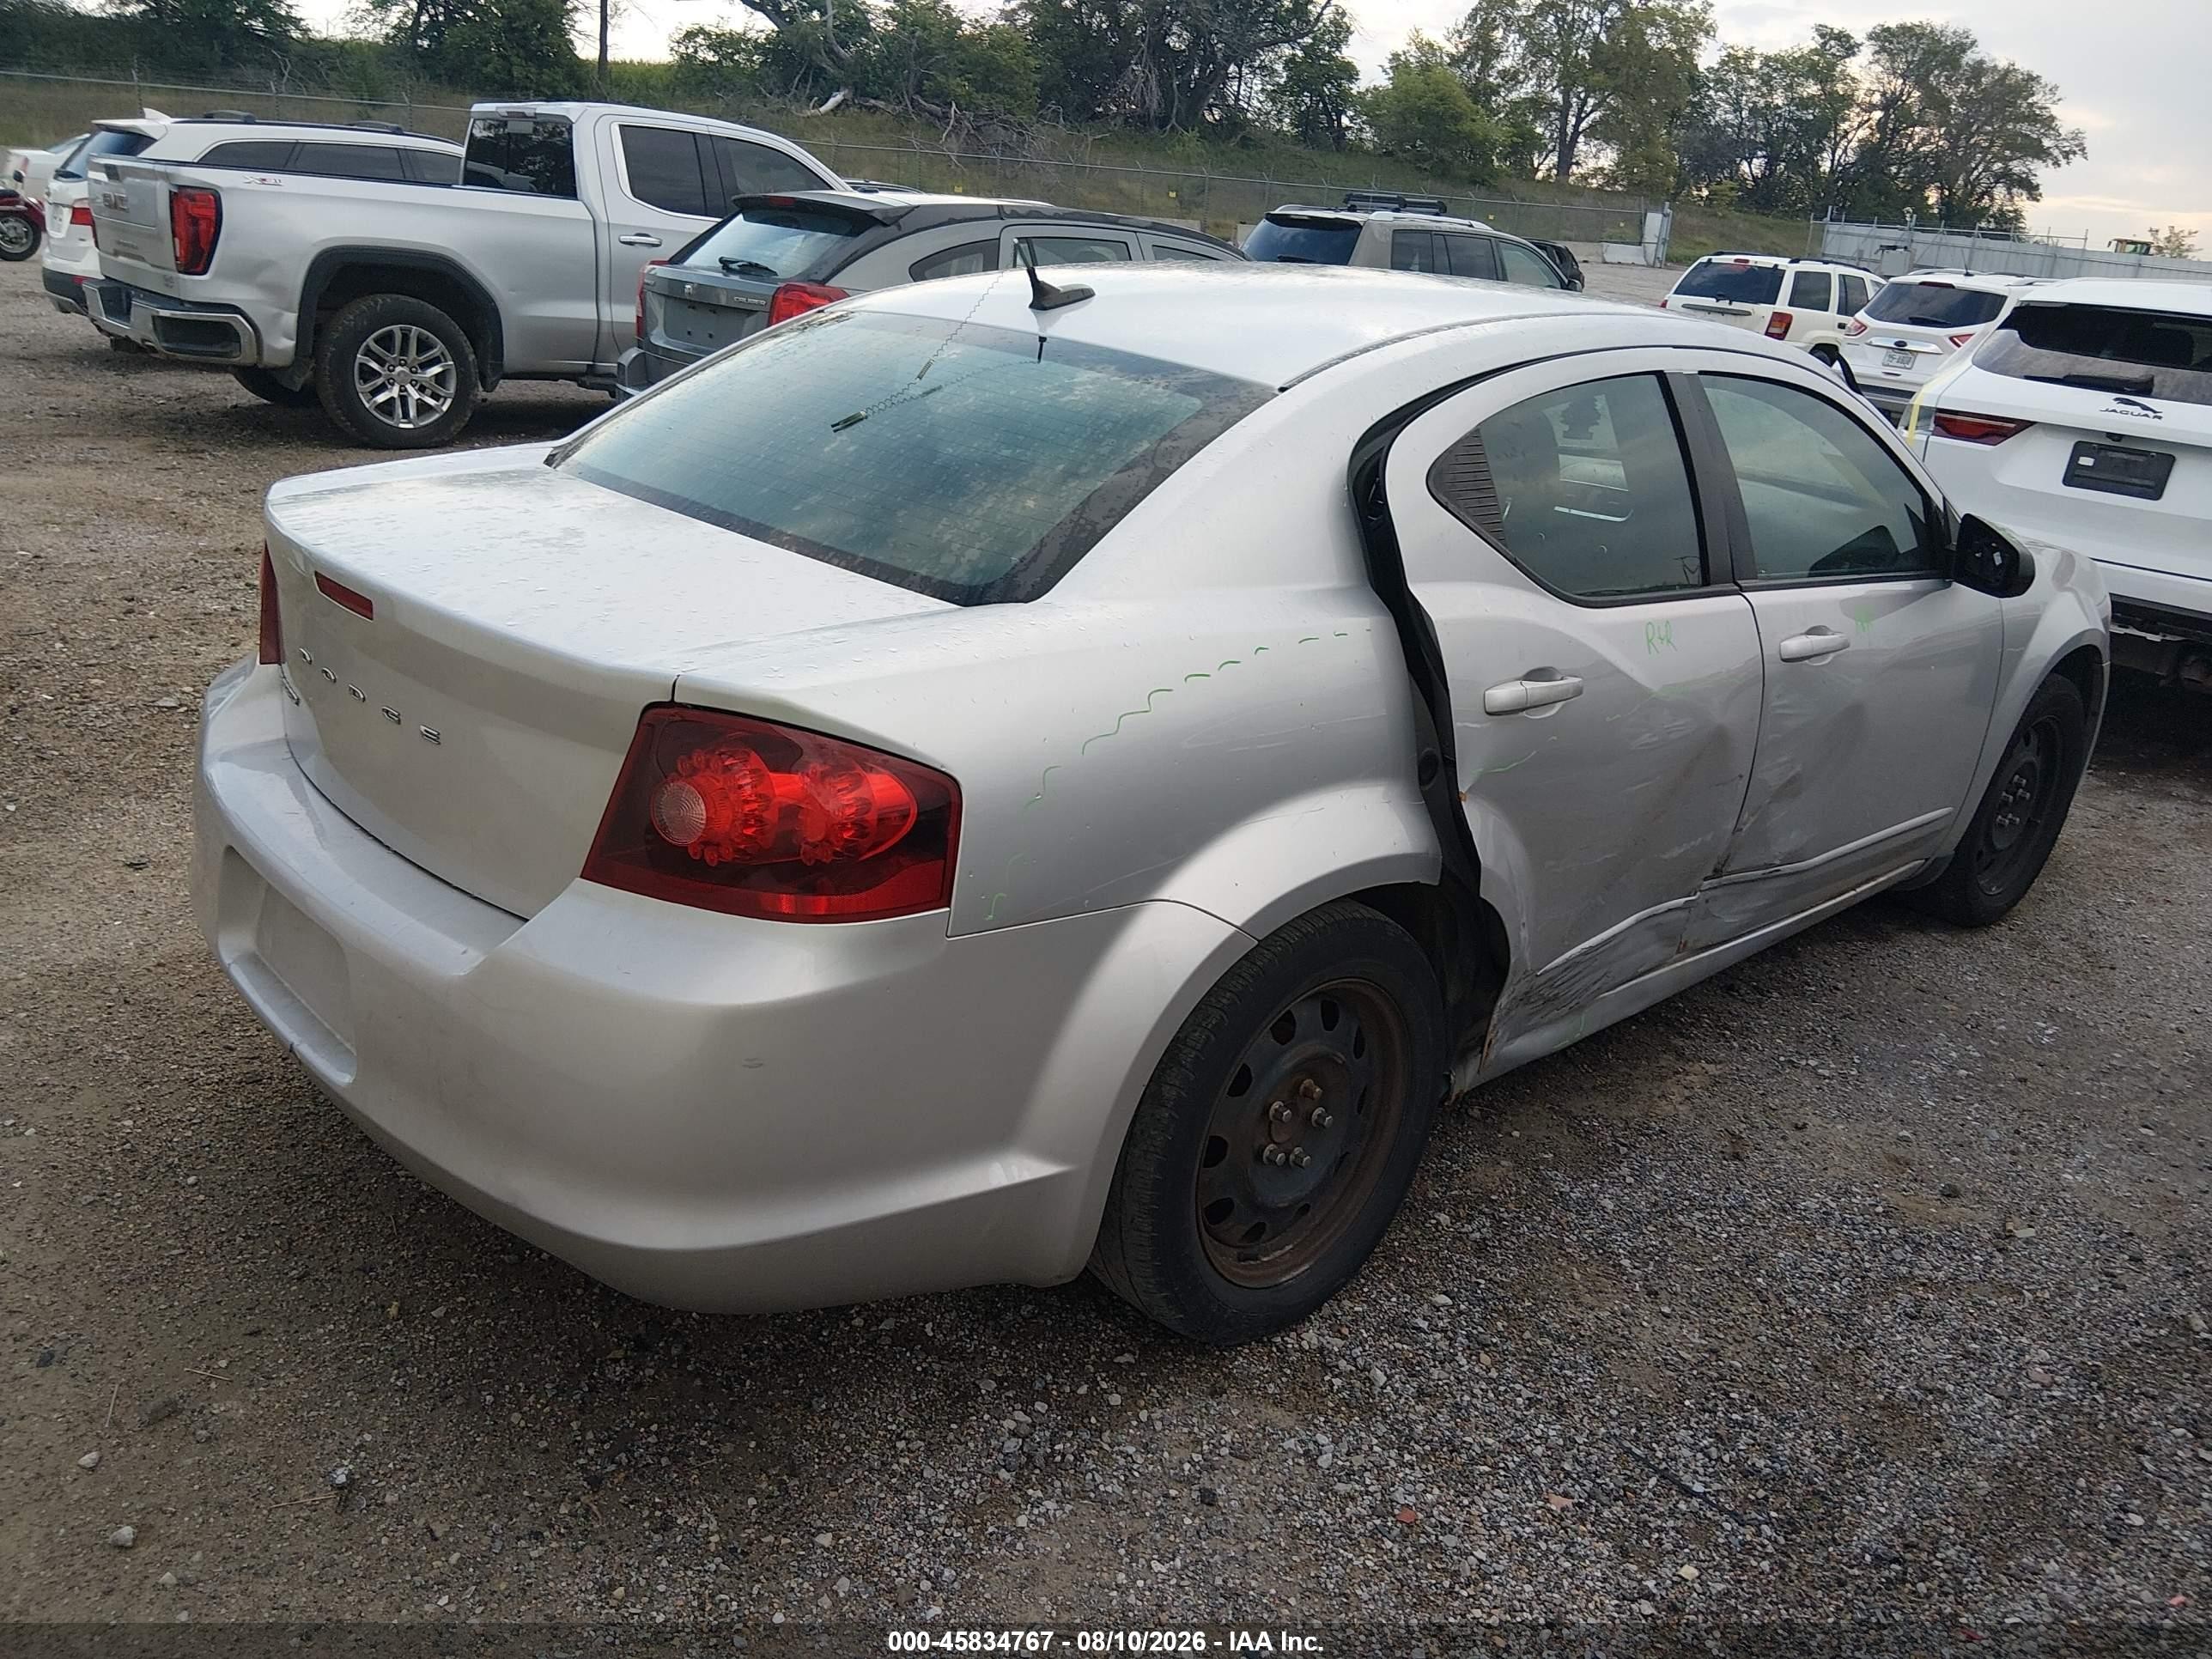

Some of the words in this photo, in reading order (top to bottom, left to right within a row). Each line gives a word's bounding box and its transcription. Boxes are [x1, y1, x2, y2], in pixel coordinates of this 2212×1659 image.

[733, 295, 767, 306] CALIBER
[2099, 407, 2164, 421] JAGUAR
[298, 647, 441, 745] DODGE
